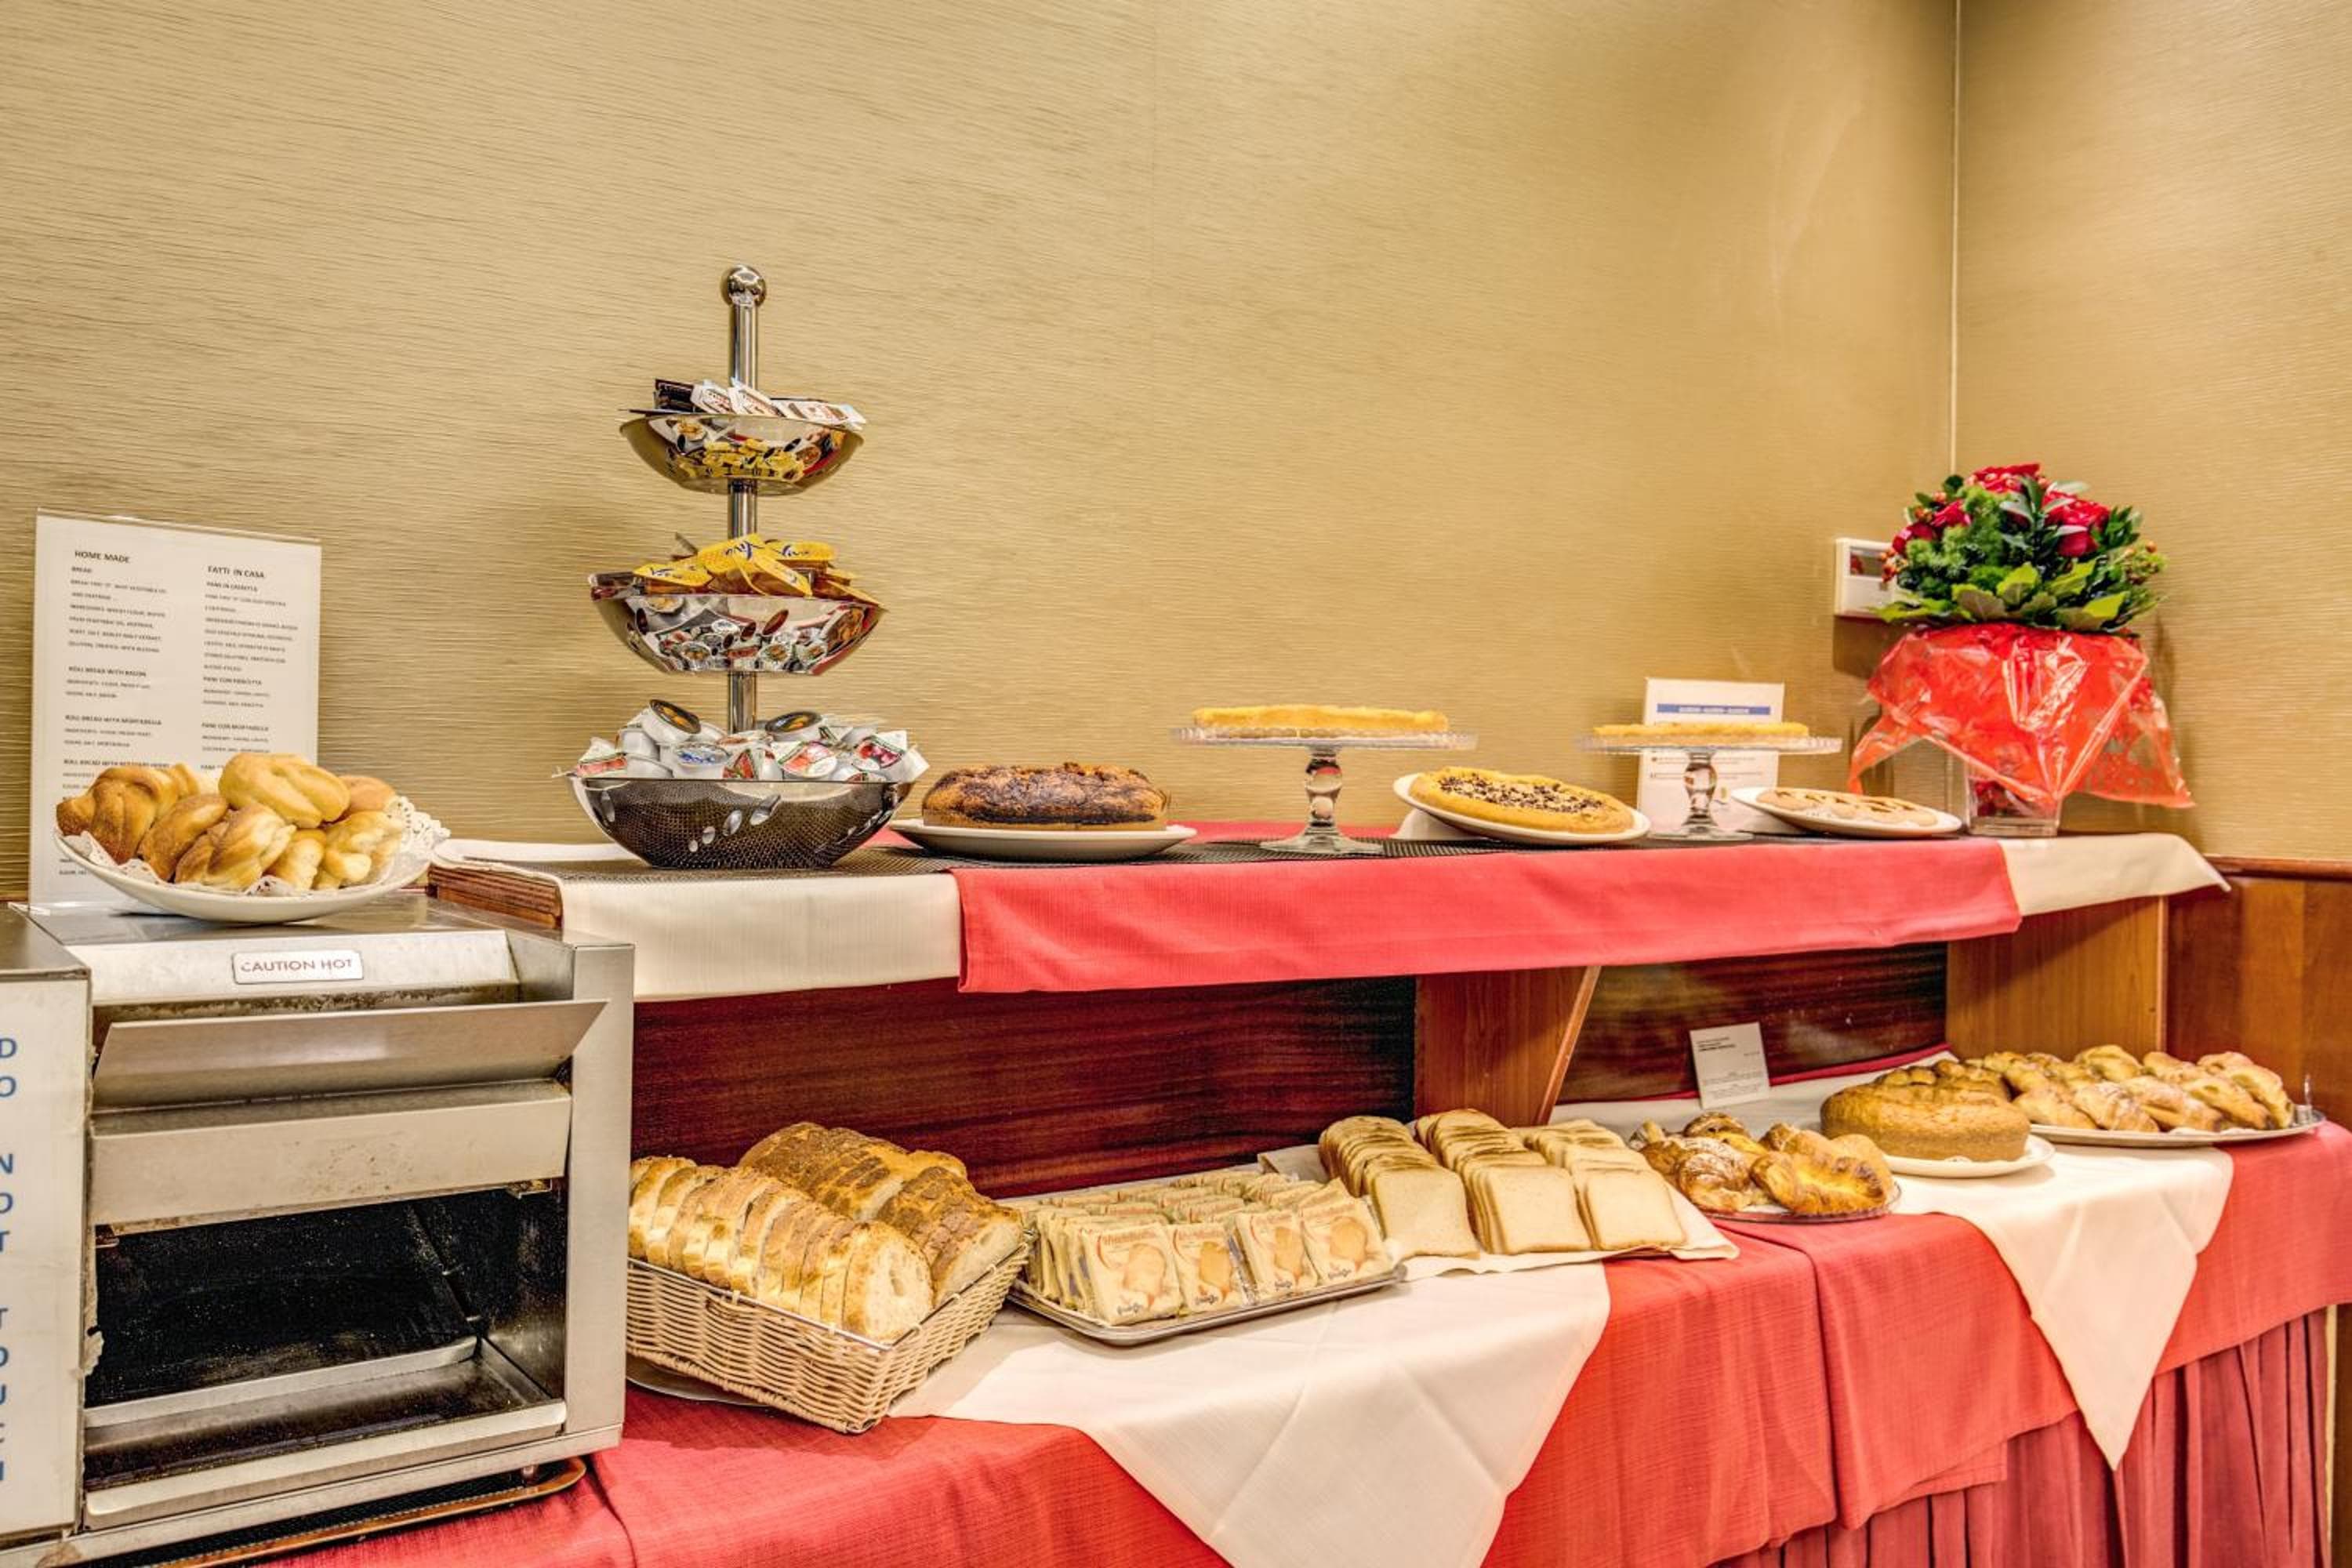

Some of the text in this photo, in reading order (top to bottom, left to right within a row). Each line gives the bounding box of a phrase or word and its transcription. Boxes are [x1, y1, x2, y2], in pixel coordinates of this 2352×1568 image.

[74, 550, 129, 564] HOME MADE
[208, 565, 230, 575] FATTI
[240, 958, 353, 973] CAUTION HOT
